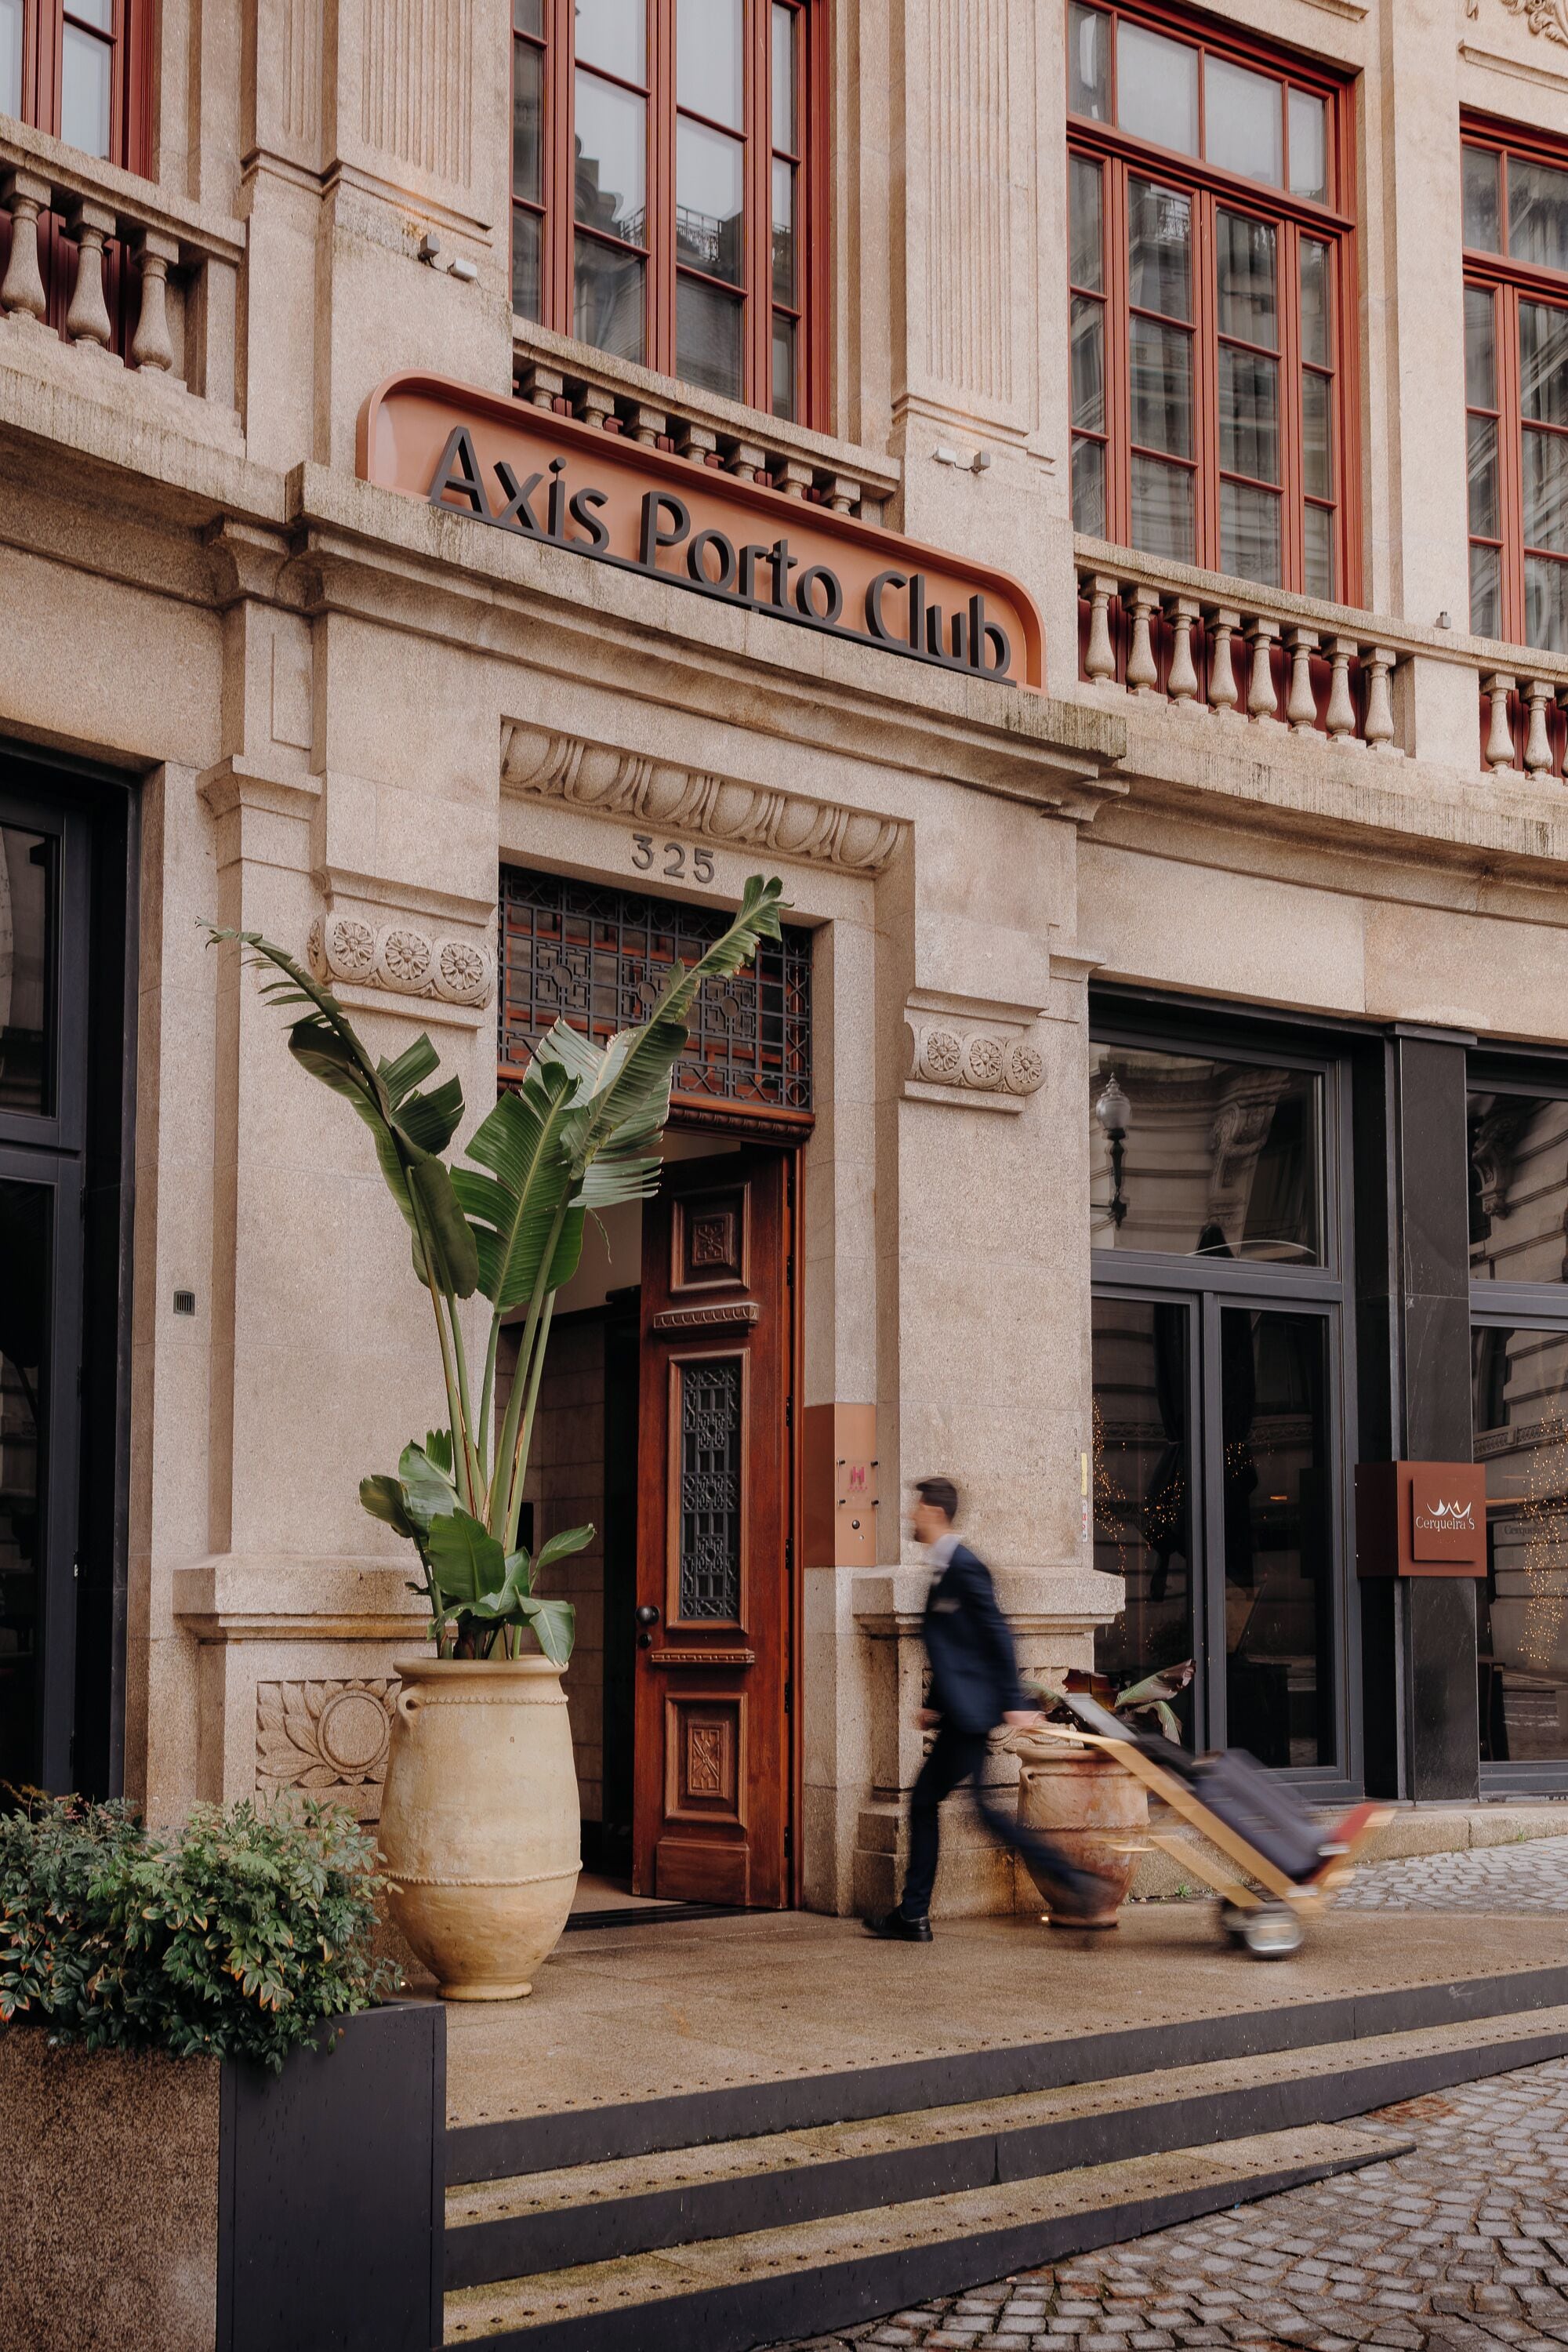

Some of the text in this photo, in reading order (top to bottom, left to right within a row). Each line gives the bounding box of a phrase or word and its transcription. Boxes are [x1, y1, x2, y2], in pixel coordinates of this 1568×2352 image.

[430, 426, 1011, 678] Axis Porto Club
[631, 833, 715, 884] 325
[1416, 1515, 1475, 1532] Cerqueira S
